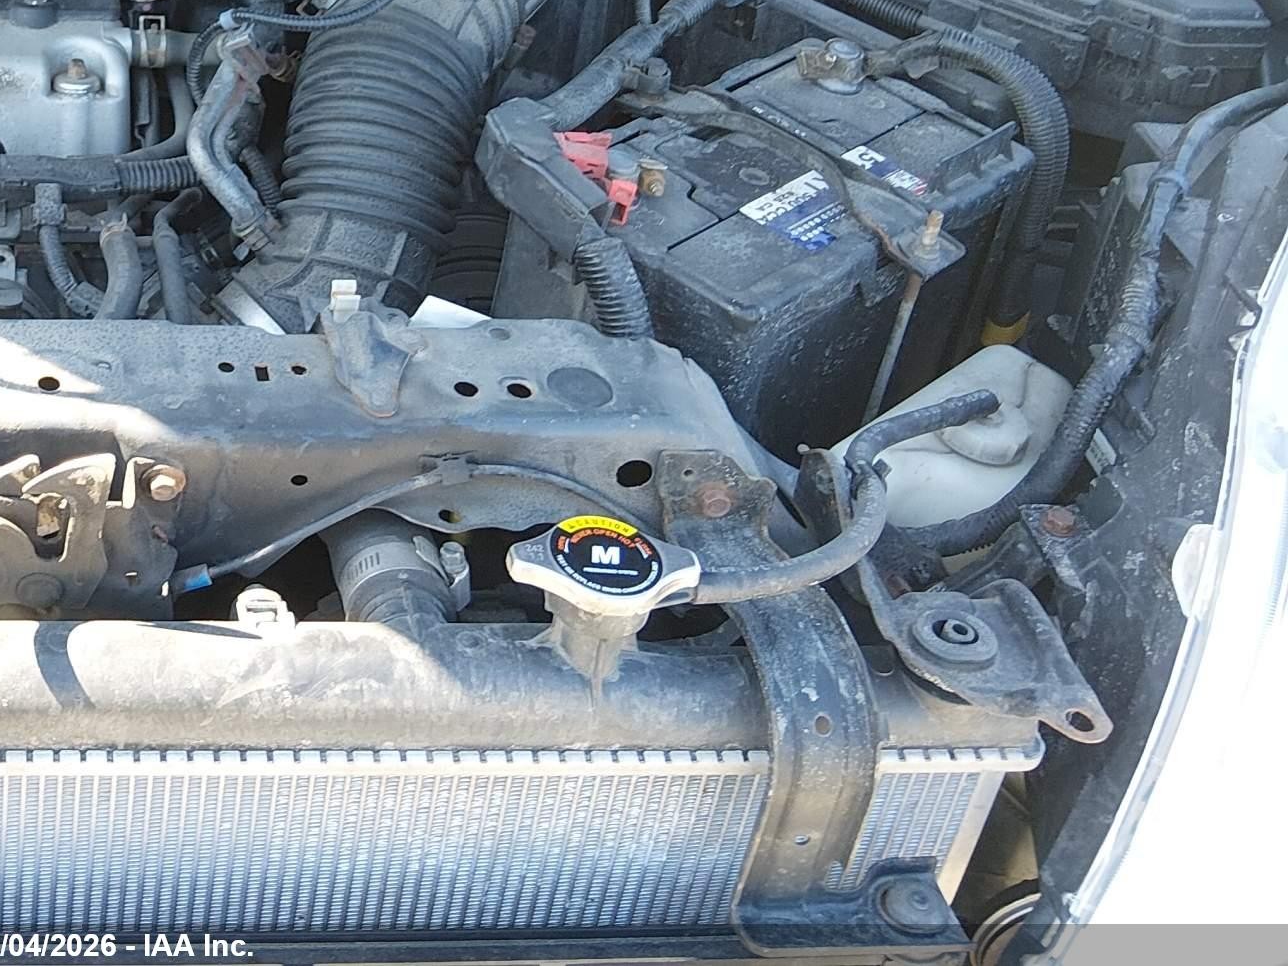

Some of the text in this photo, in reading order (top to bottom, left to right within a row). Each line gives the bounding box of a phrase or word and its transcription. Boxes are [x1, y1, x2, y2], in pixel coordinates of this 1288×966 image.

[577, 518, 630, 533] CAUTION
[617, 536, 636, 549] HOT
[591, 545, 620, 565] M
